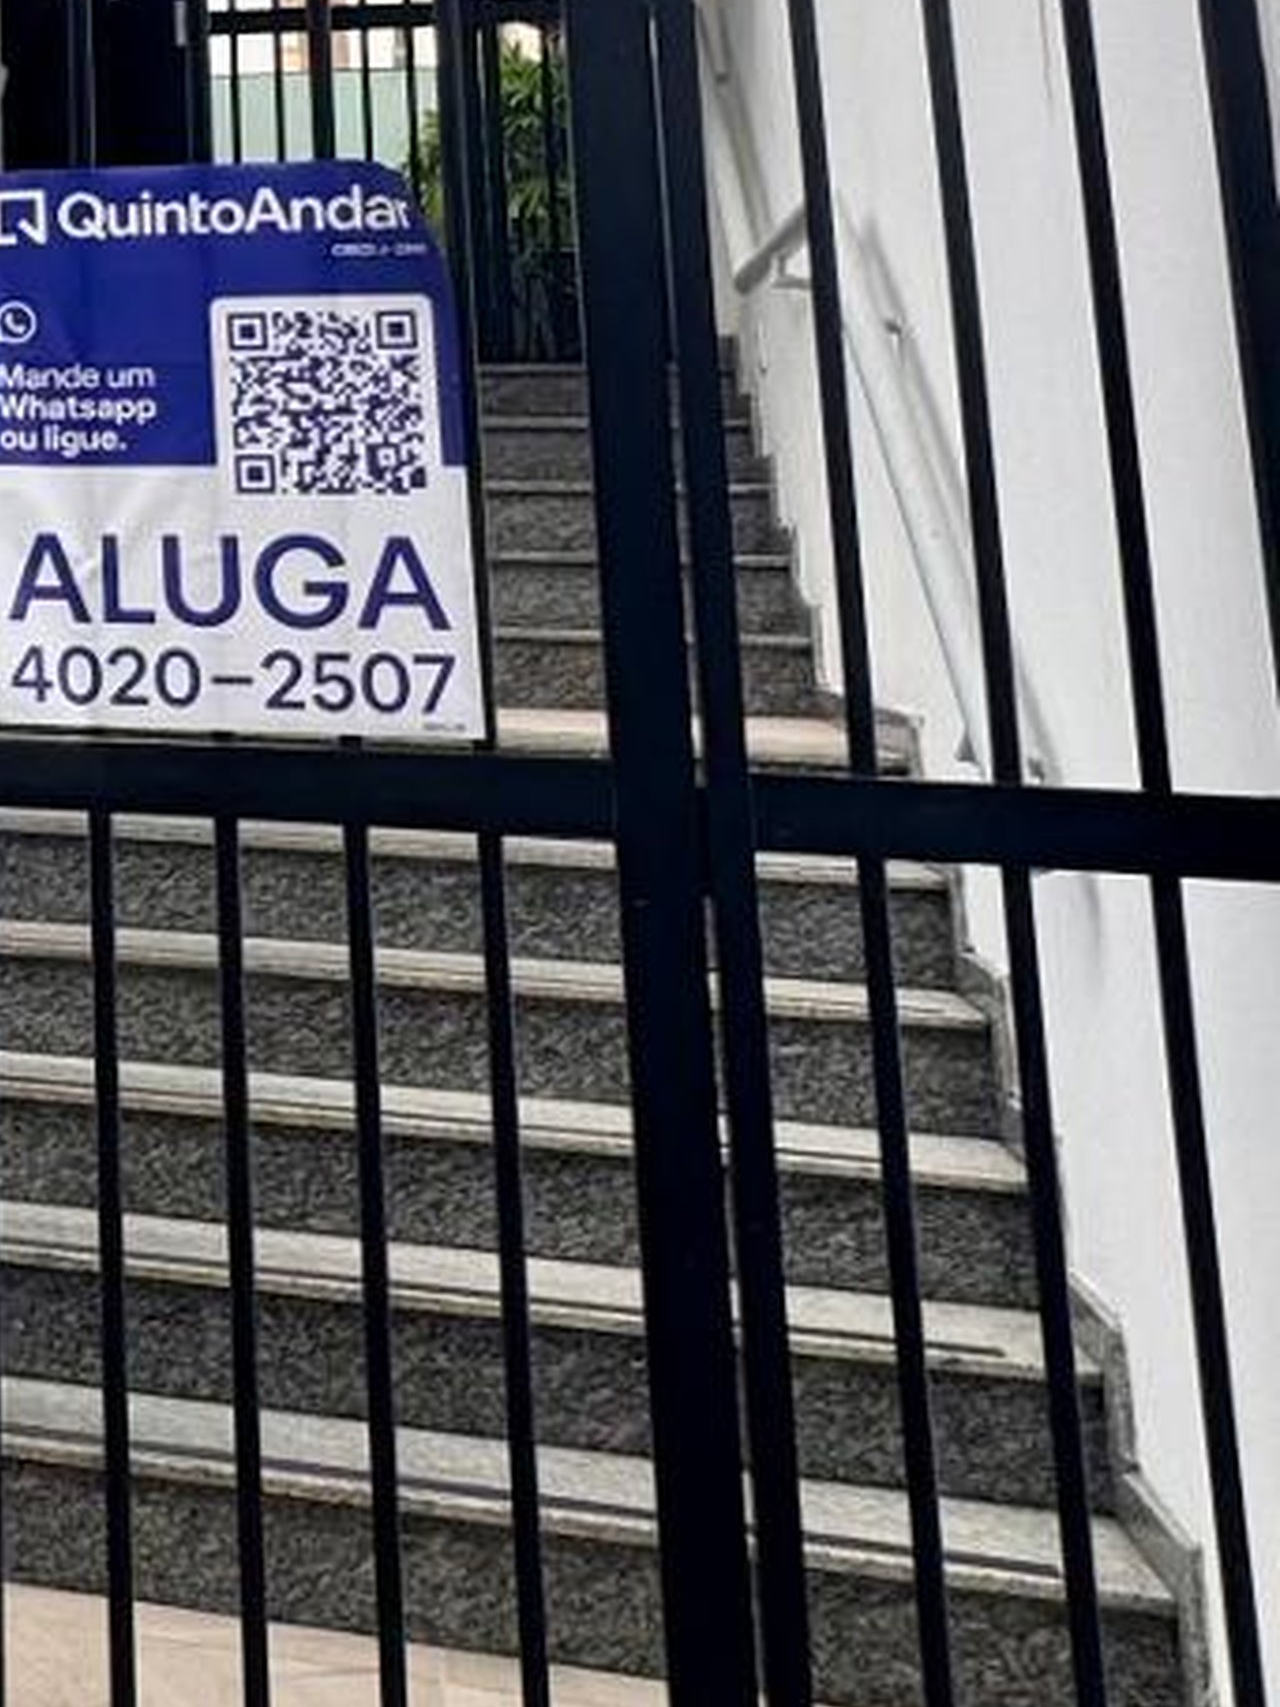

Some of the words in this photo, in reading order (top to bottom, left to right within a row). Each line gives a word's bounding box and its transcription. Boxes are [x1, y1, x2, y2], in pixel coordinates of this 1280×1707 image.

[57, 185, 411, 240] QuintoAndar
[108, 366, 156, 389] um
[0, 430, 38, 451] ou
[43, 426, 128, 460] ligue.
[8, 534, 452, 630] ALUGA
[10, 644, 456, 717] 4020-2507
